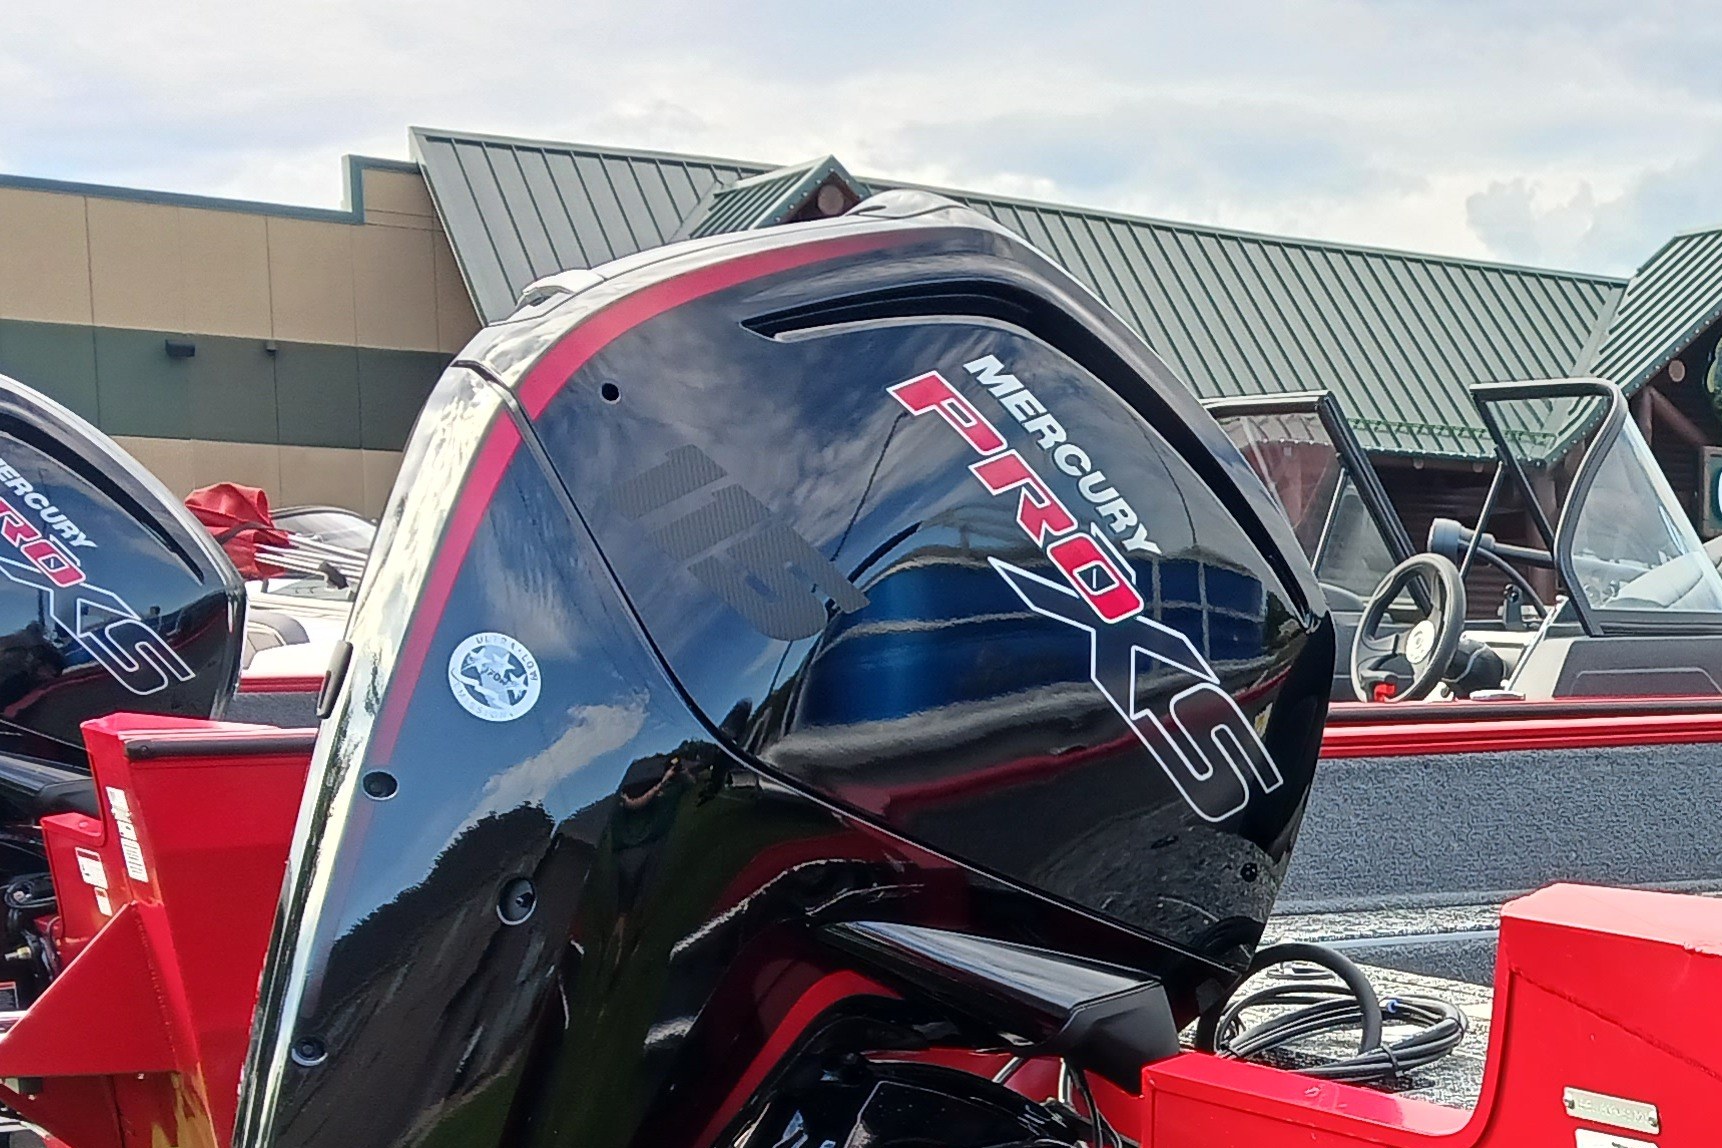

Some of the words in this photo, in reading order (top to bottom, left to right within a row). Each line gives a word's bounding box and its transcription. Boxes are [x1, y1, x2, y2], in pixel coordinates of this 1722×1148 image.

[0, 458, 98, 548] ERCURY
[886, 369, 1144, 624] PRO
[963, 354, 1163, 556] MERCURY
